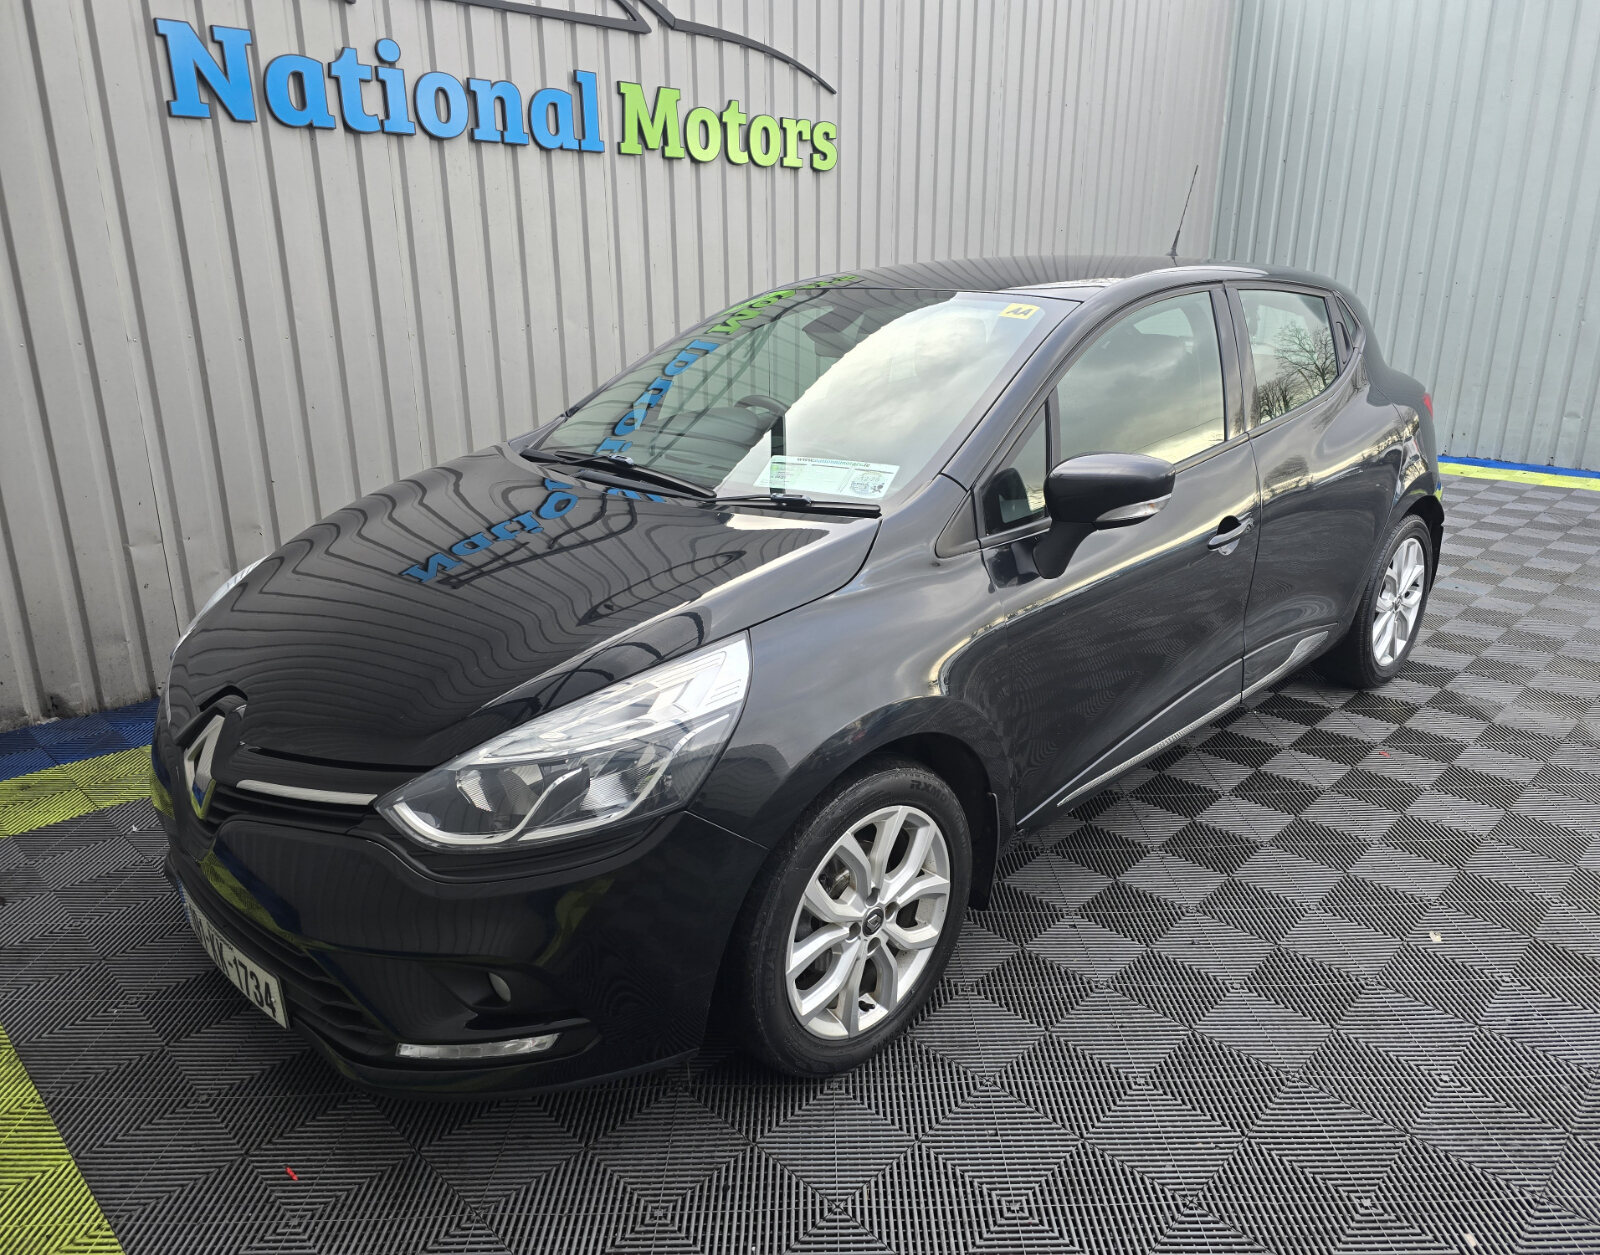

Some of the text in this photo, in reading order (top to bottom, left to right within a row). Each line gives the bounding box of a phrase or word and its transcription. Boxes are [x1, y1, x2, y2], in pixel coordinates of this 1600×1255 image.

[153, 16, 839, 172] National Motors
[1006, 306, 1033, 316] AA
